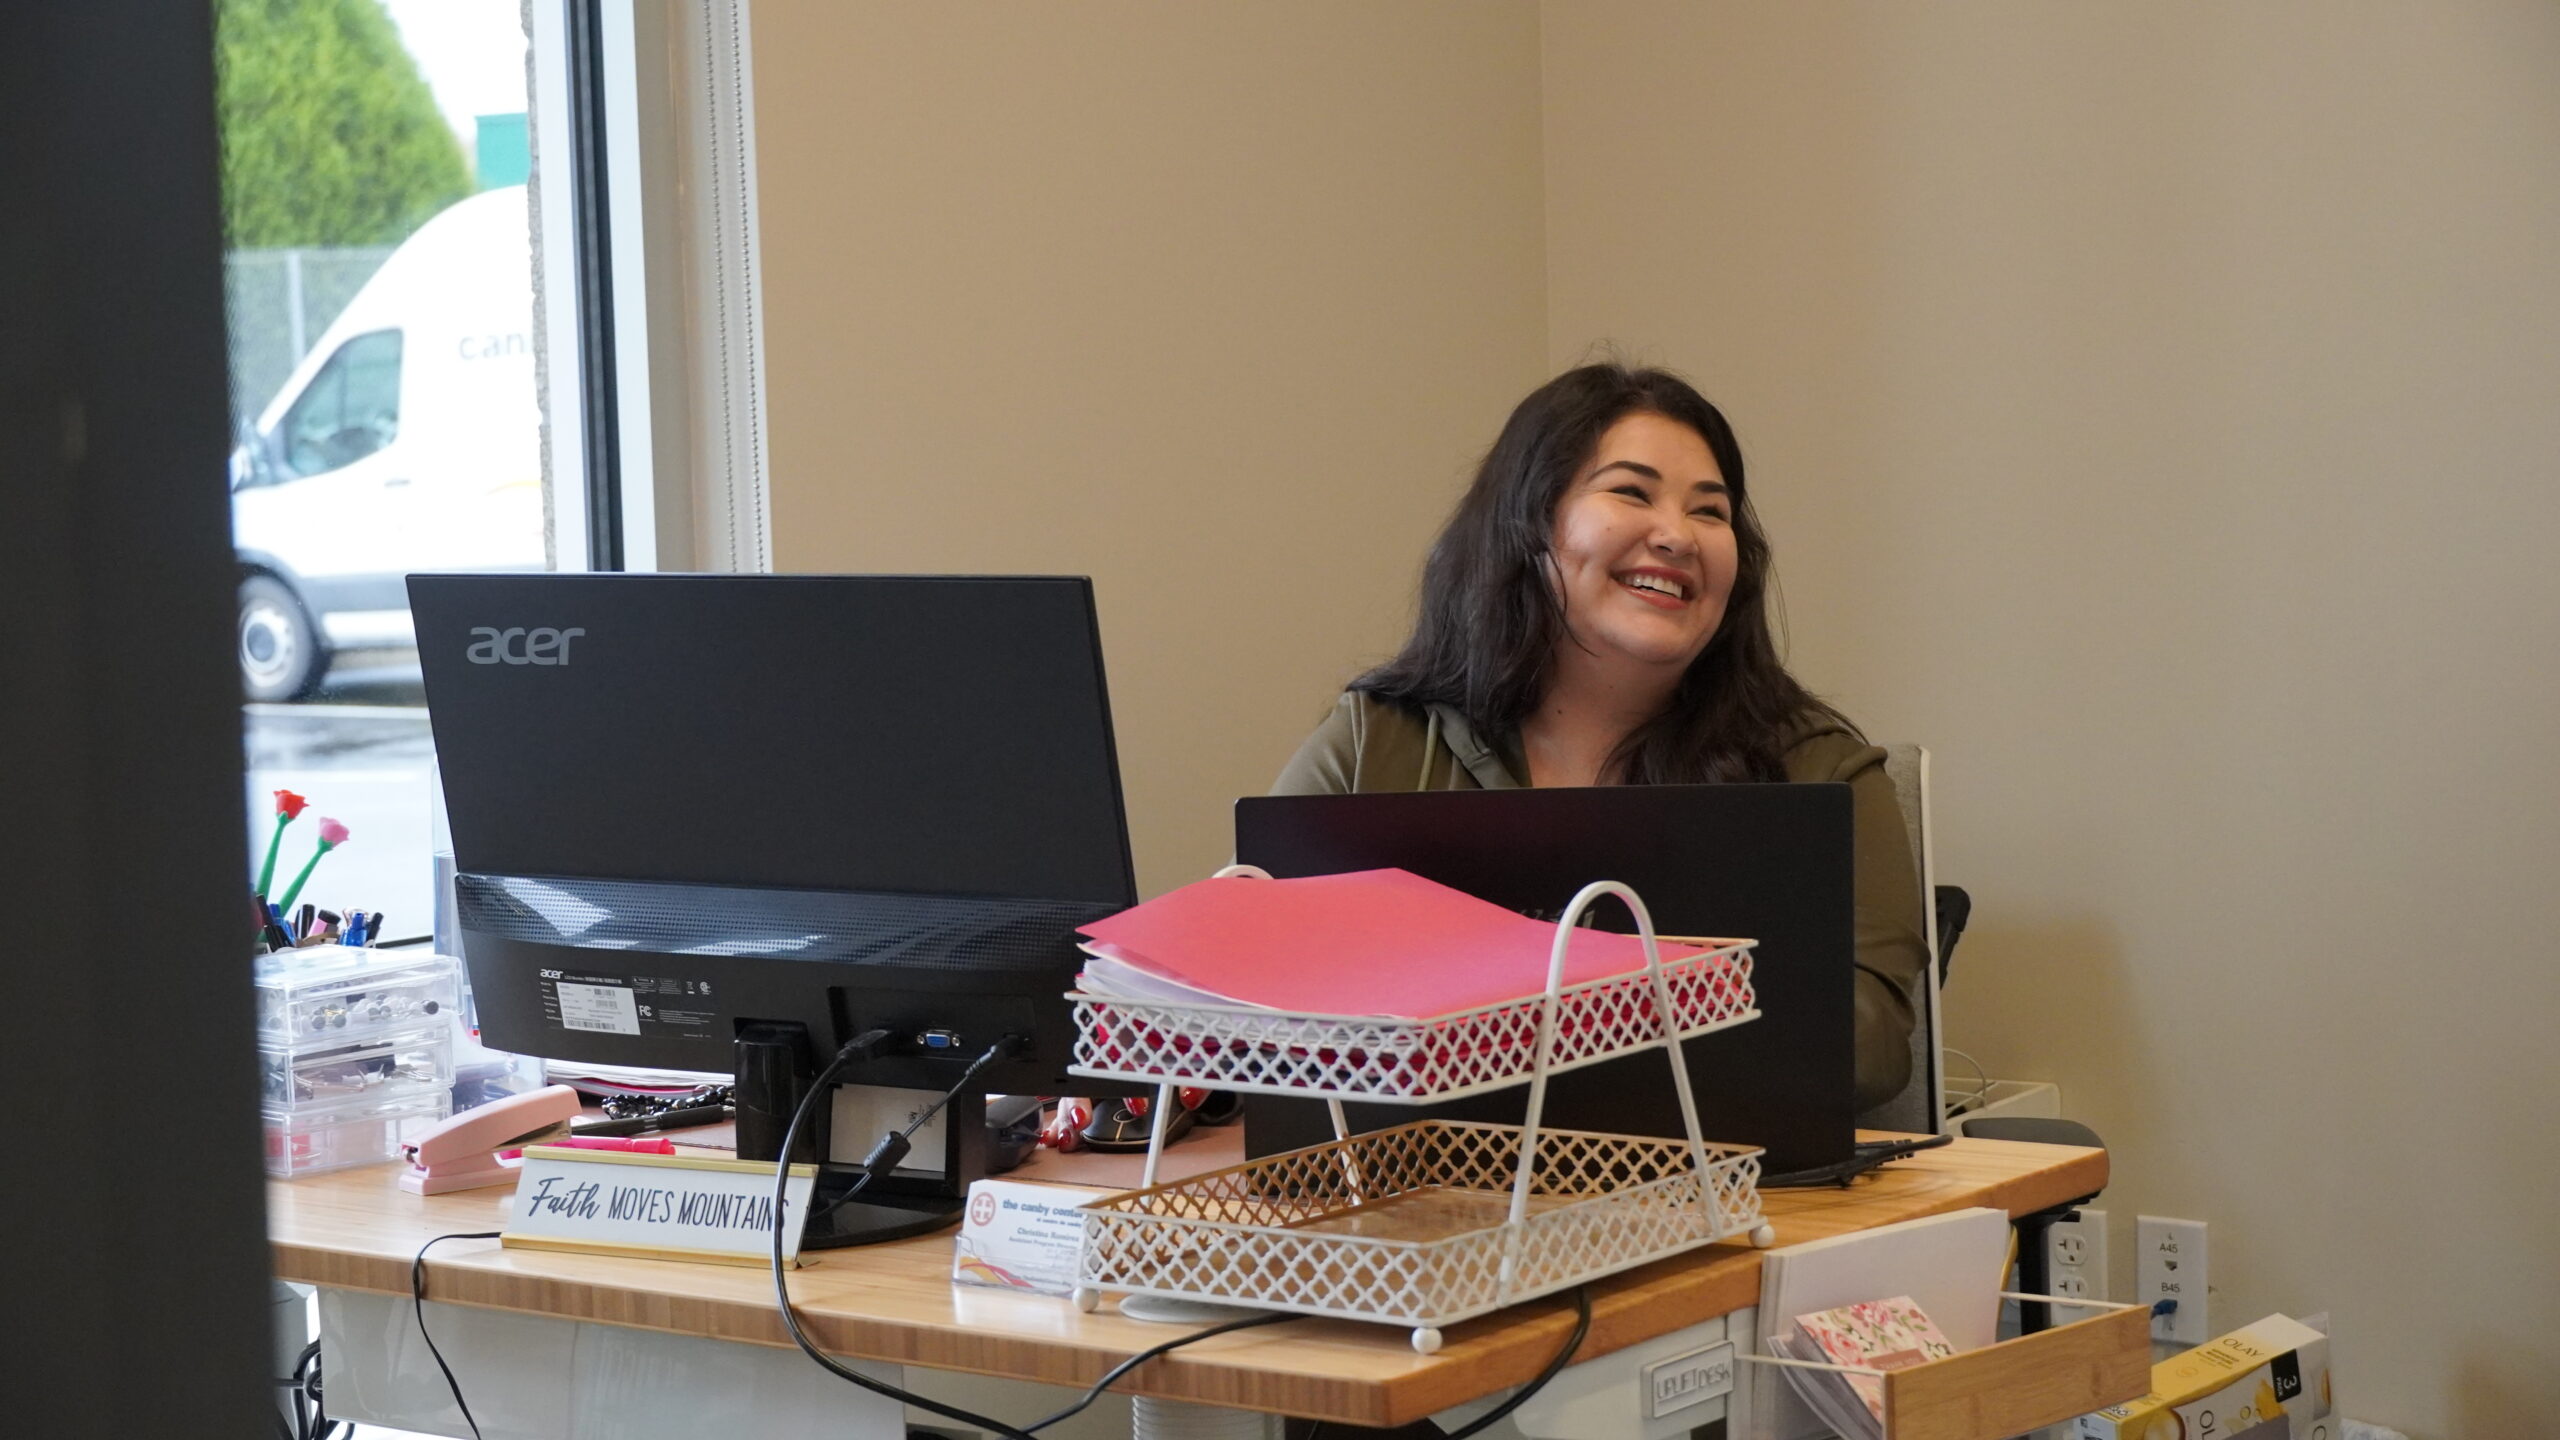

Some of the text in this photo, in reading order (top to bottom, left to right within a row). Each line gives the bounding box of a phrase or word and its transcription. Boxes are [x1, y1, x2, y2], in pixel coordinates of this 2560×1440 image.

[466, 626, 586, 666] acer
[540, 968, 564, 980] acer
[528, 1177, 600, 1220] Faith
[607, 1186, 675, 1224] MOVES
[1002, 1198, 1018, 1210] the
[1021, 1202, 1049, 1216] canby
[2160, 1242, 2178, 1254] A45
[2161, 1282, 2181, 1293] B45
[2223, 1338, 2264, 1357] OLAY
[2283, 1375, 2297, 1389] 3
